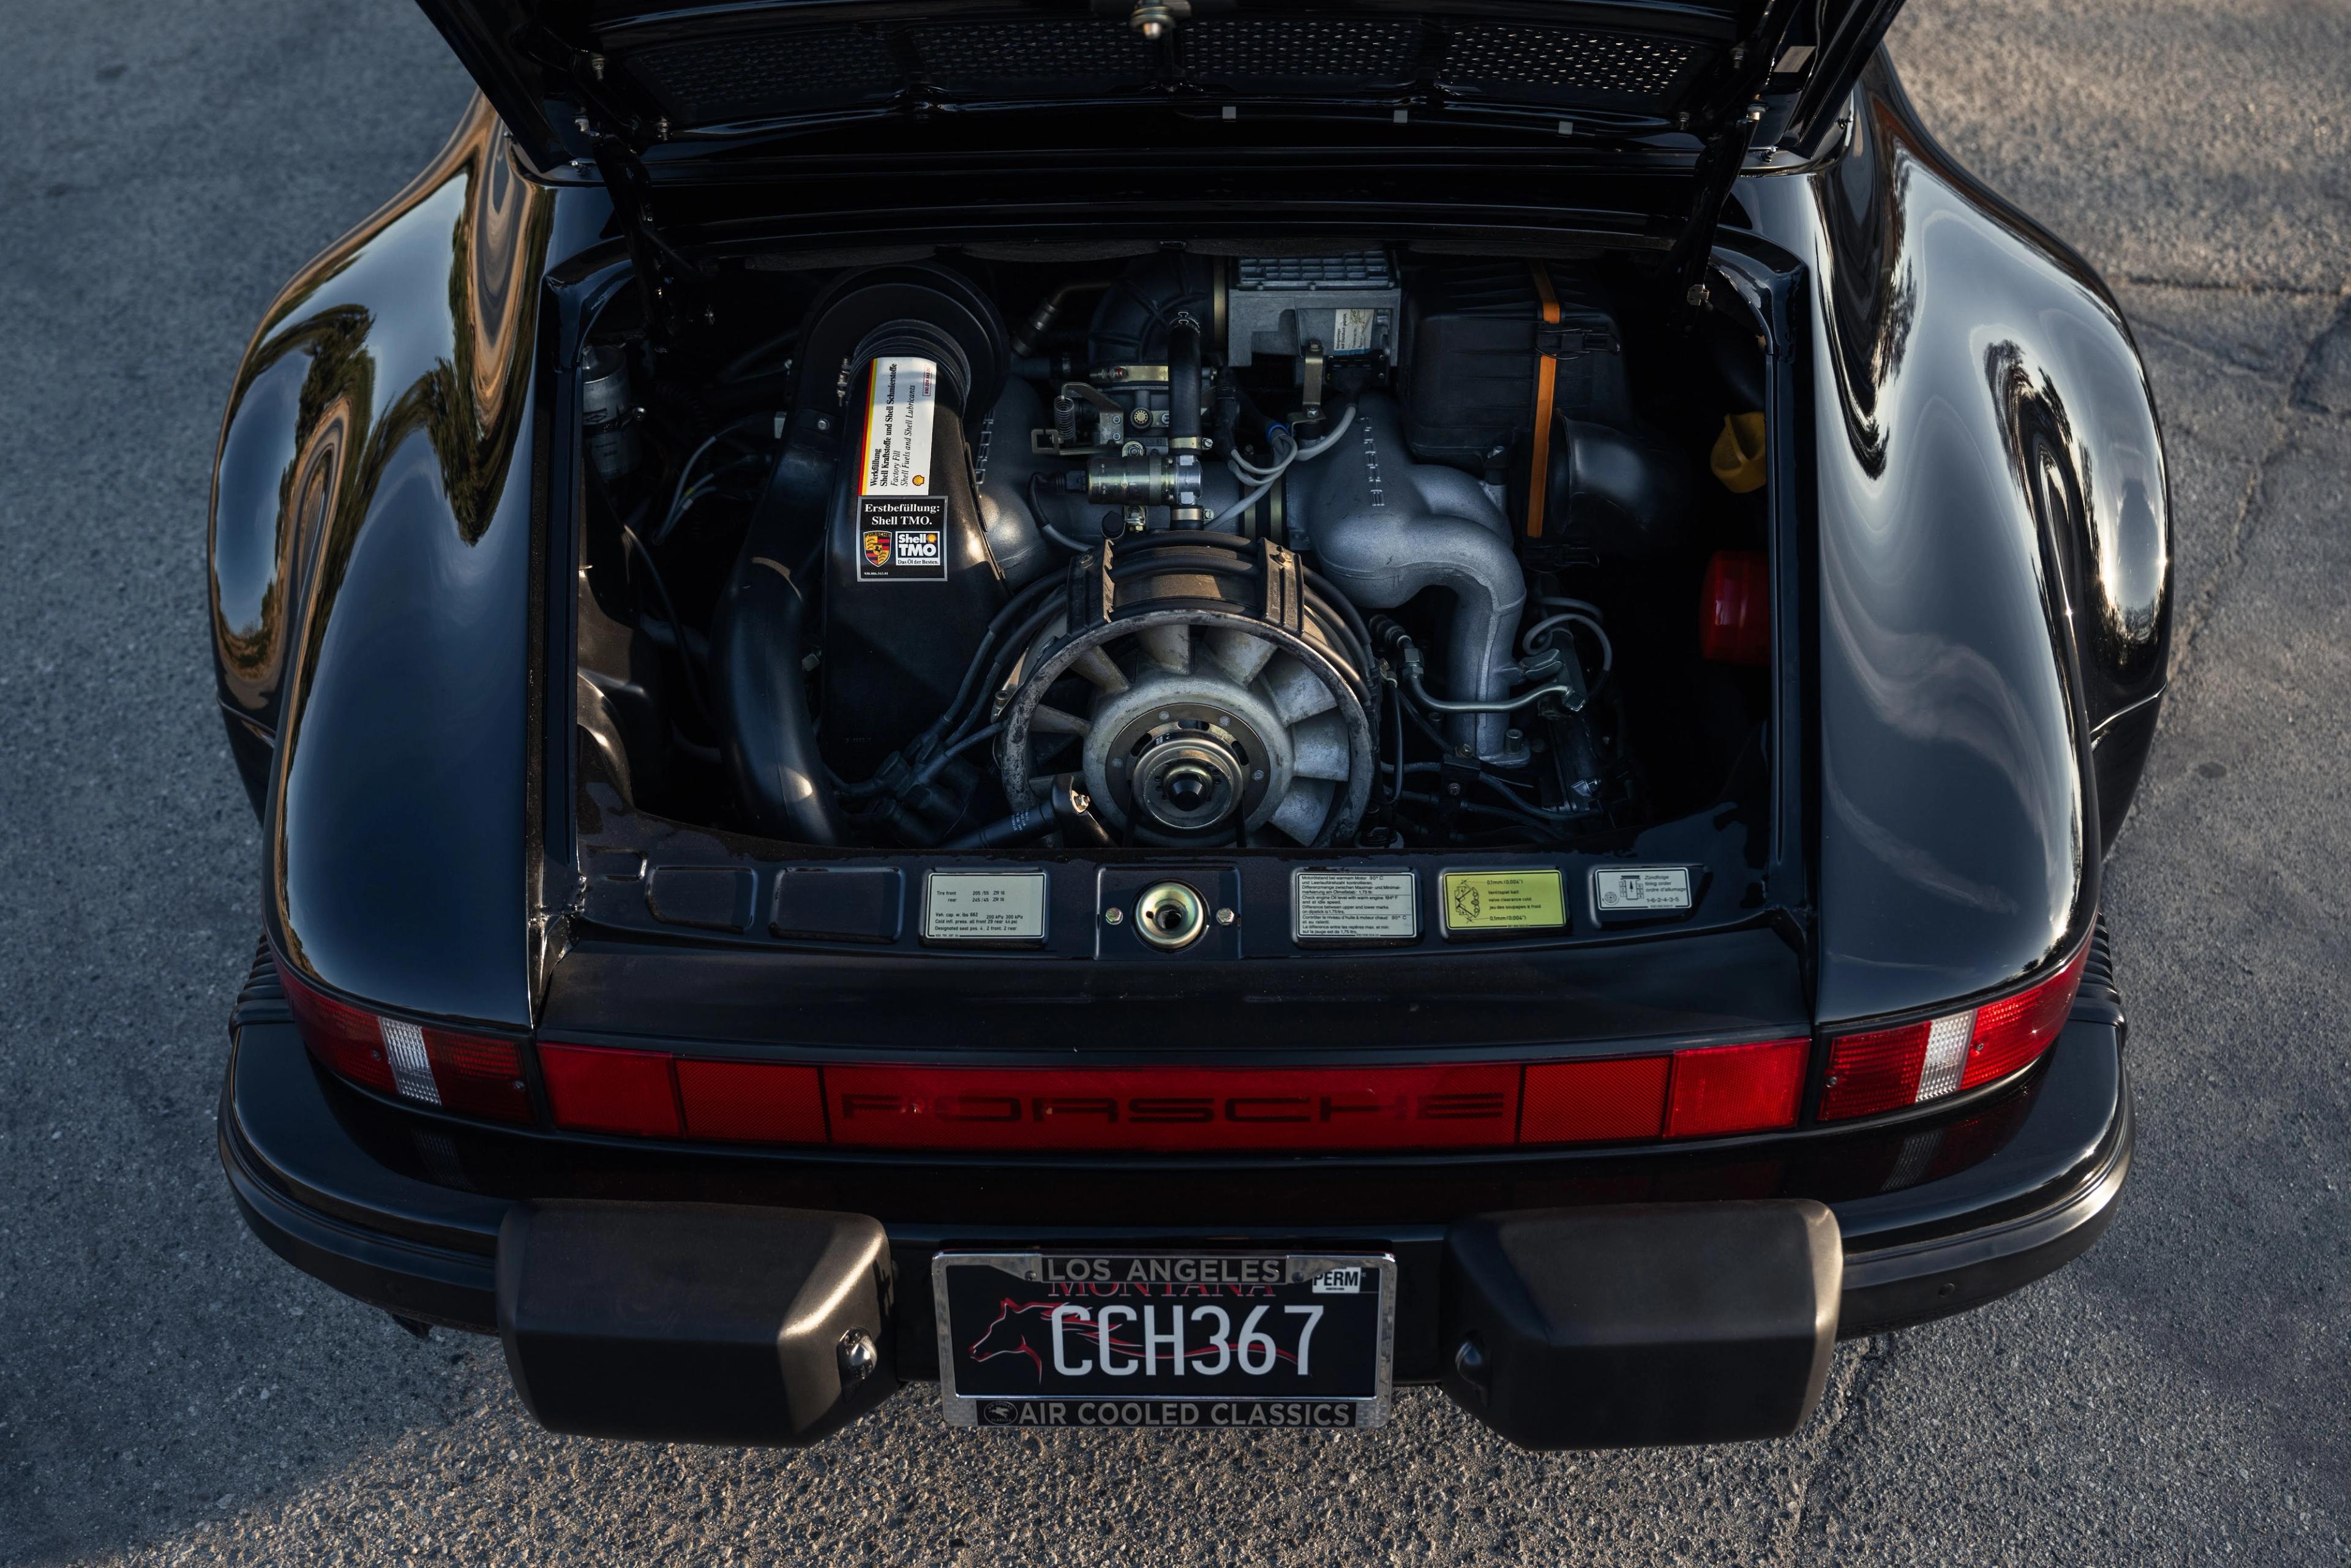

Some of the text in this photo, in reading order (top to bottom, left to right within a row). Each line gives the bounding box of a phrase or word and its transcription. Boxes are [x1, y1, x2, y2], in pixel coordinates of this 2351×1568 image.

[906, 385, 915, 418] Lubricants
[882, 437, 891, 468] Kraftstoffe
[887, 363, 897, 404] Schmierstoffe
[870, 448, 882, 487] Werkfüllung
[902, 451, 910, 468] Fuels
[891, 463, 901, 486] Factory
[901, 470, 909, 487] Shell
[864, 503, 940, 514] Erstbefüllung:
[872, 516, 932, 525] Shell TMO.
[898, 533, 926, 544] Shell
[898, 544, 937, 557] TMO
[1048, 1258, 1280, 1282] LOS ANGELES
[1313, 1272, 1359, 1286] PERM
[1051, 1305, 1324, 1376] CCH367
[1019, 1402, 1349, 1425] AIR COOLED CLASSICS
